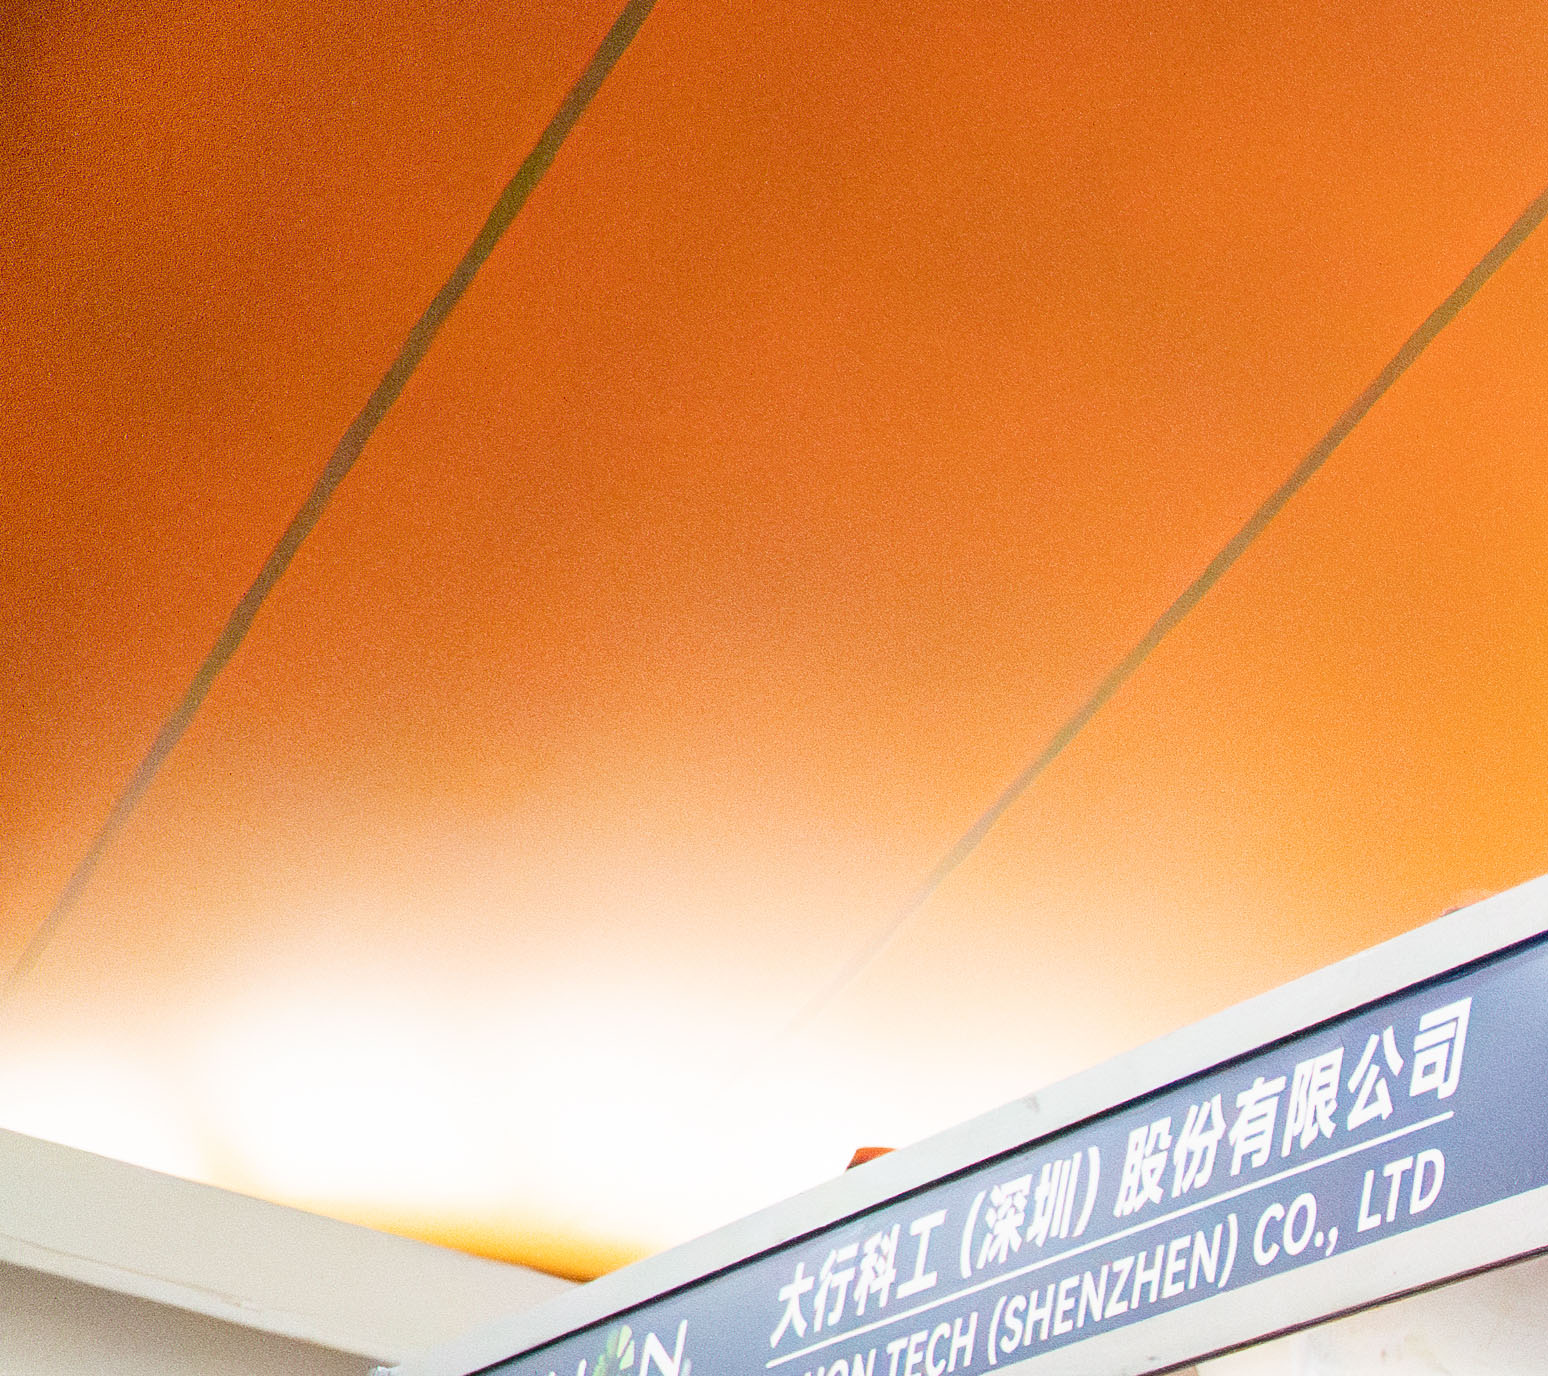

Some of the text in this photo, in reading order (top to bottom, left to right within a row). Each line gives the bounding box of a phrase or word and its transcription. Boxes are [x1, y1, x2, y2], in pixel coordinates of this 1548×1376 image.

[986, 1224, 1240, 1371] (SHENZHEN)
[1252, 1196, 1340, 1262] CO.,
[1355, 1147, 1447, 1234] LTD
